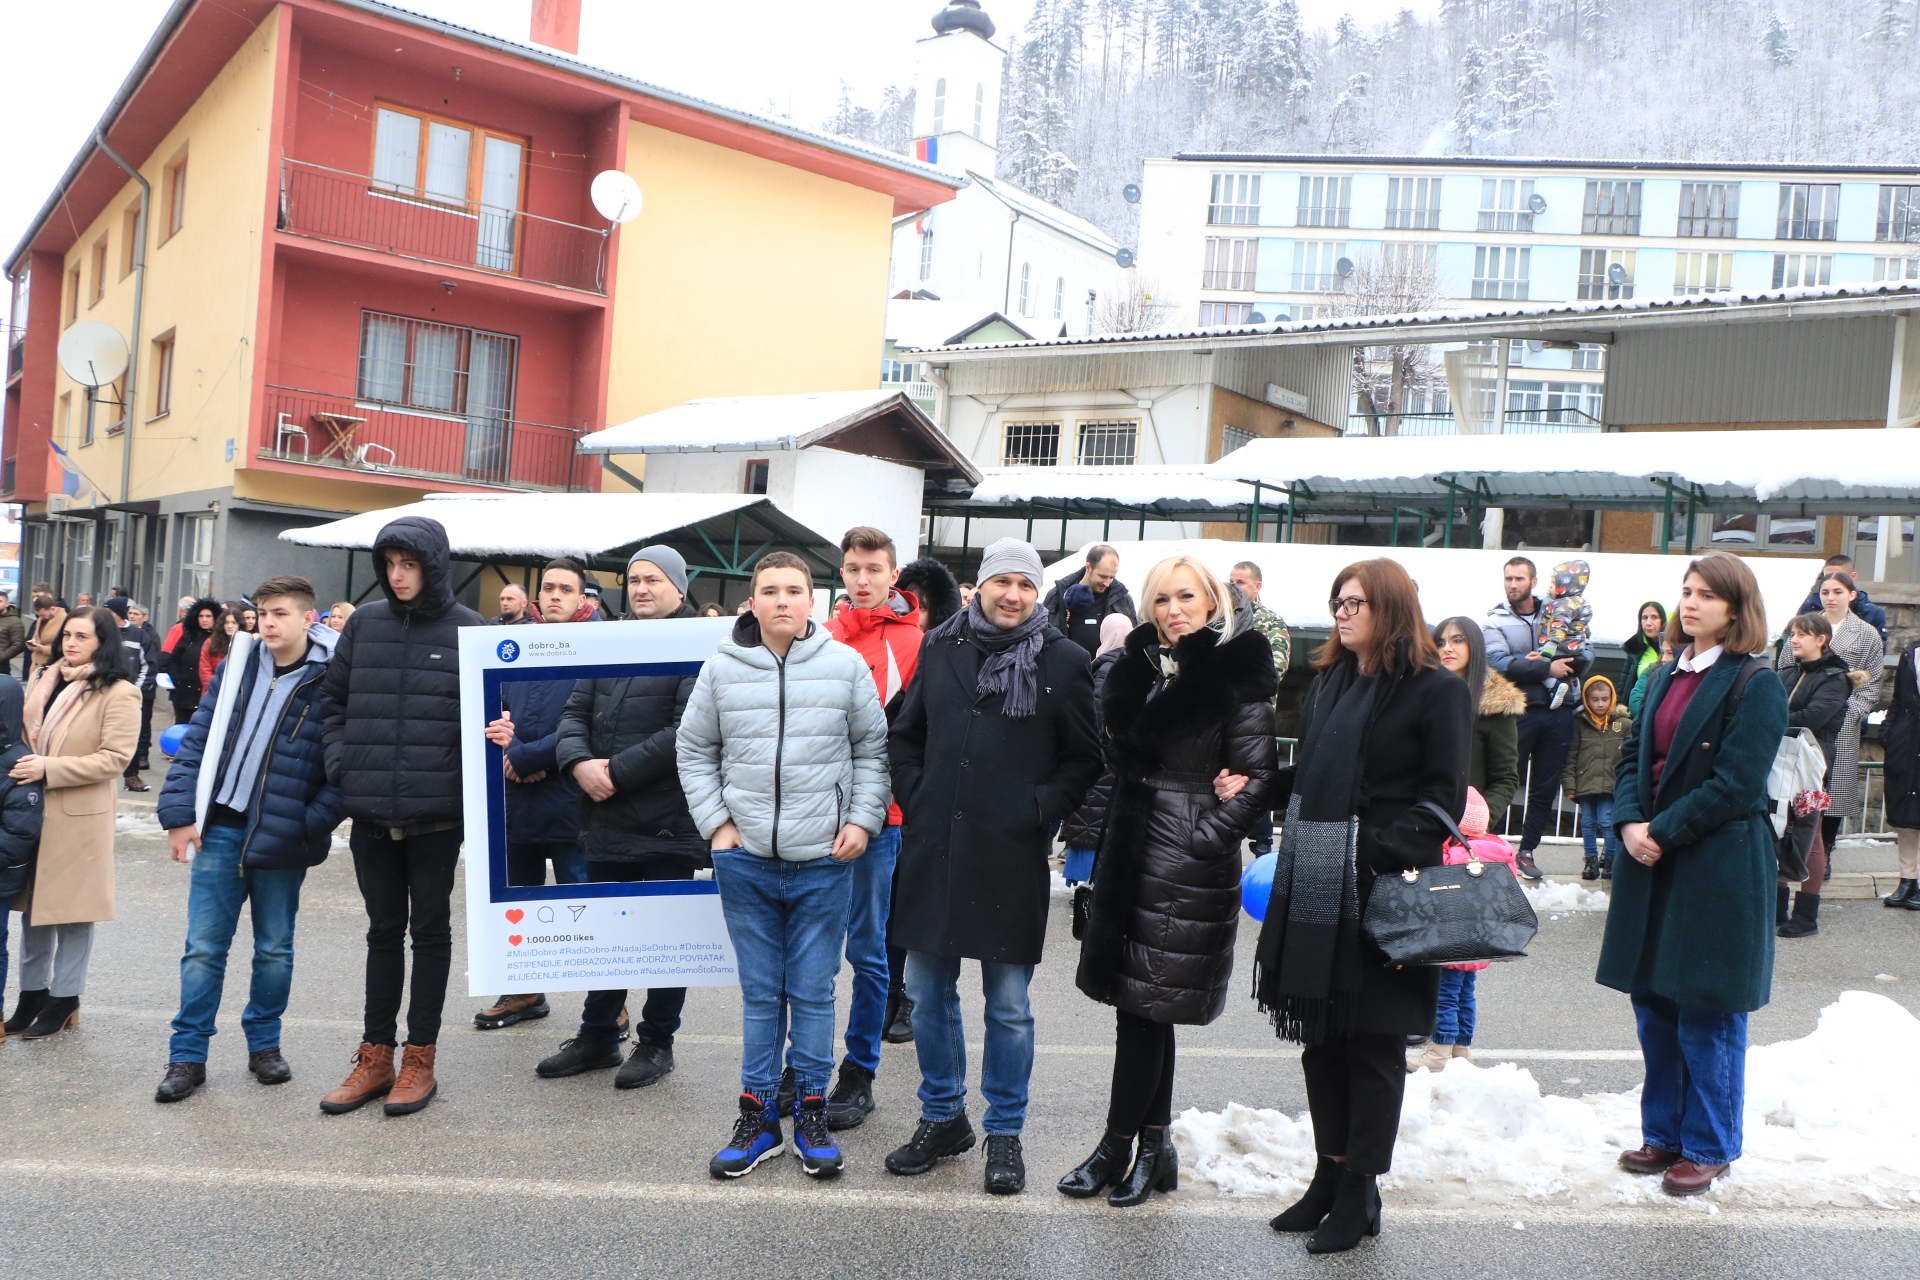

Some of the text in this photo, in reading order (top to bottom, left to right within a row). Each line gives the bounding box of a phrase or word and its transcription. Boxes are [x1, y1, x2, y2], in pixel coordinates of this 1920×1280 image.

[528, 641, 570, 650] dobro_ba
[526, 934, 594, 944] 1.000.000 likes
[507, 942, 723, 958] #MisliDobro #RadiDobro #NadajSeDobru #Dobro.ba
[507, 954, 726, 970] #STIPENDIJE #OBRAZOVANJE #ODRŽIVI_POVRATAK
[561, 968, 639, 979] #BitiDobarJeDobro
[640, 965, 735, 976] #NašeJeSamoŠtoDamo
